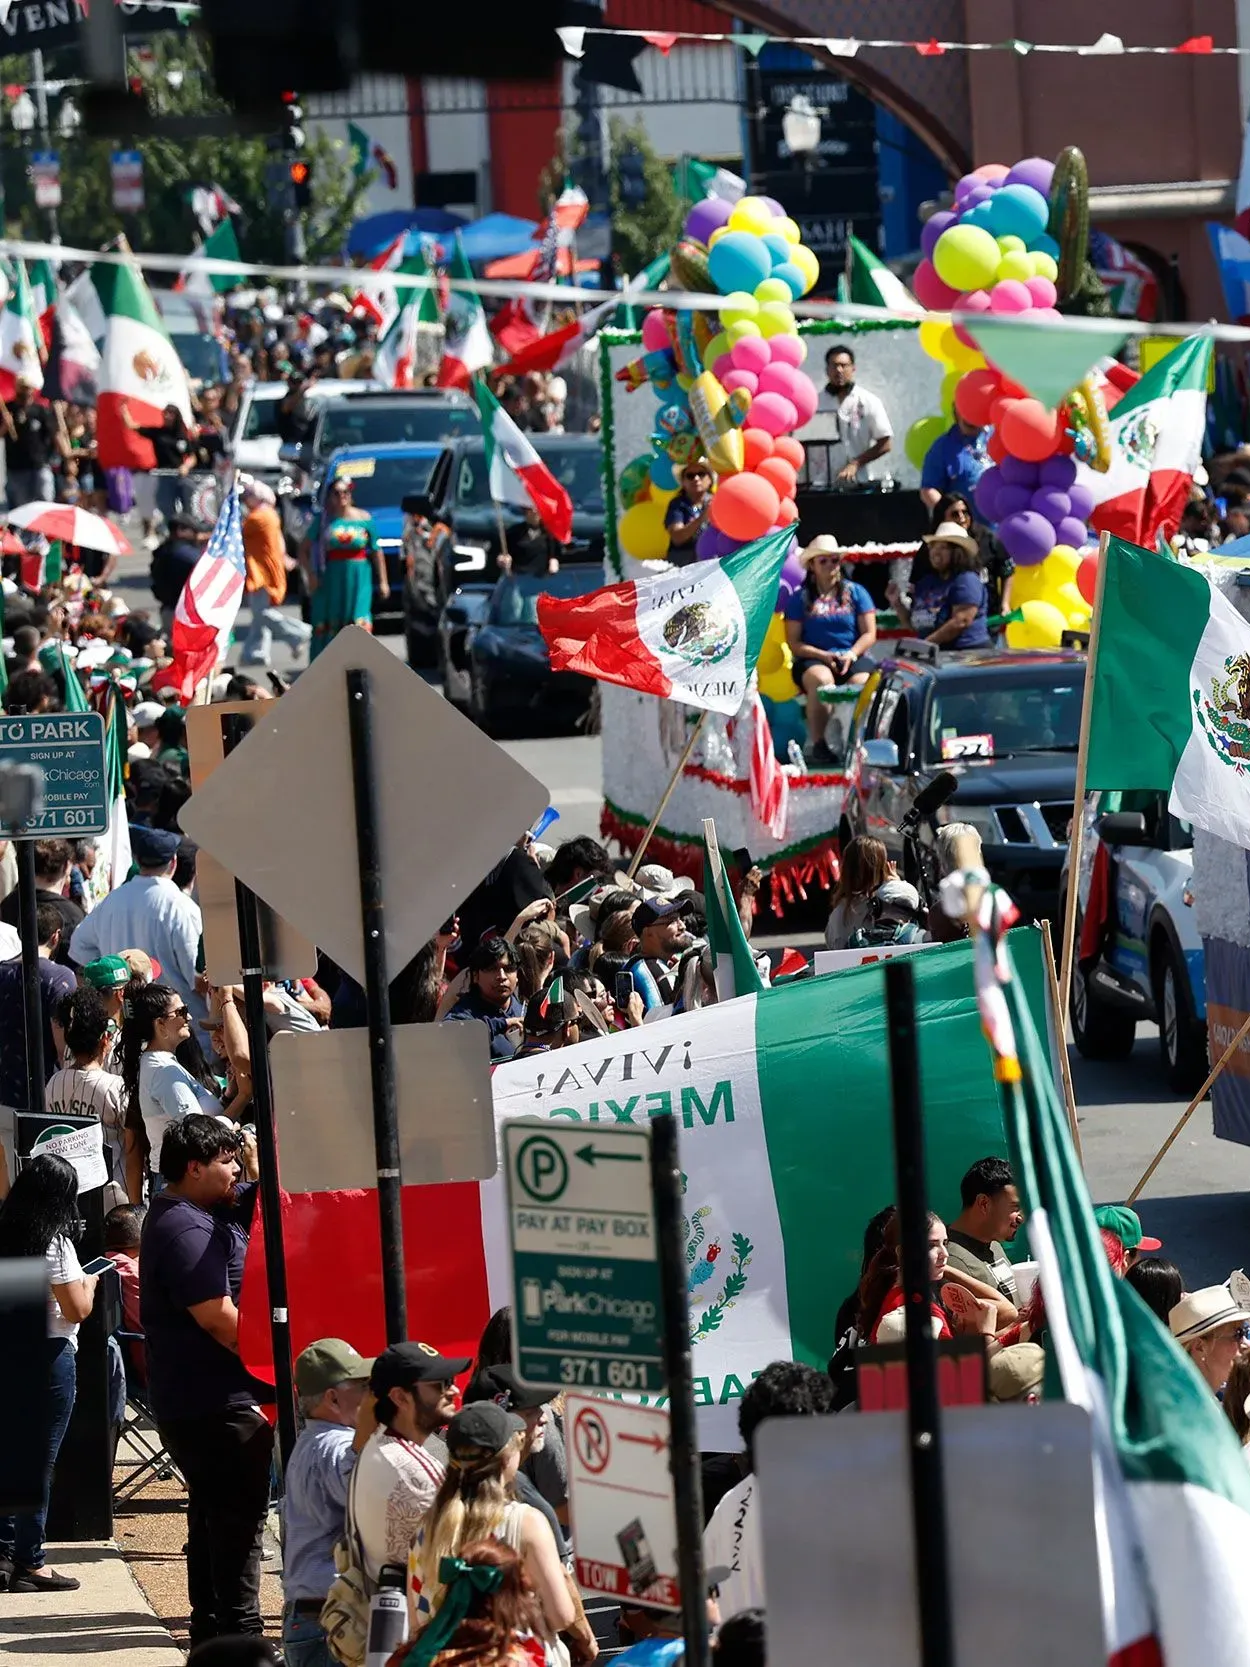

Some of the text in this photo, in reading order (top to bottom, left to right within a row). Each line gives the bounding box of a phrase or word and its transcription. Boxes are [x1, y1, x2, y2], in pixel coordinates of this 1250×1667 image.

[0, 720, 90, 741] TO PARK
[30, 751, 50, 760] SIGN
[65, 750, 76, 759] AT
[41, 768, 99, 782] kChicago
[73, 792, 88, 801] PAY
[64, 809, 95, 825] 601
[45, 1131, 89, 1150] NO PARKING
[69, 1139, 88, 1150] ZONE
[517, 1212, 649, 1239] PAY AT PAY BOX
[543, 1288, 656, 1323] ParkChicago
[572, 1331, 609, 1345] MOBILE
[559, 1357, 600, 1384] 371
[607, 1361, 648, 1389] 601
[580, 1561, 675, 1604] TOW NE
